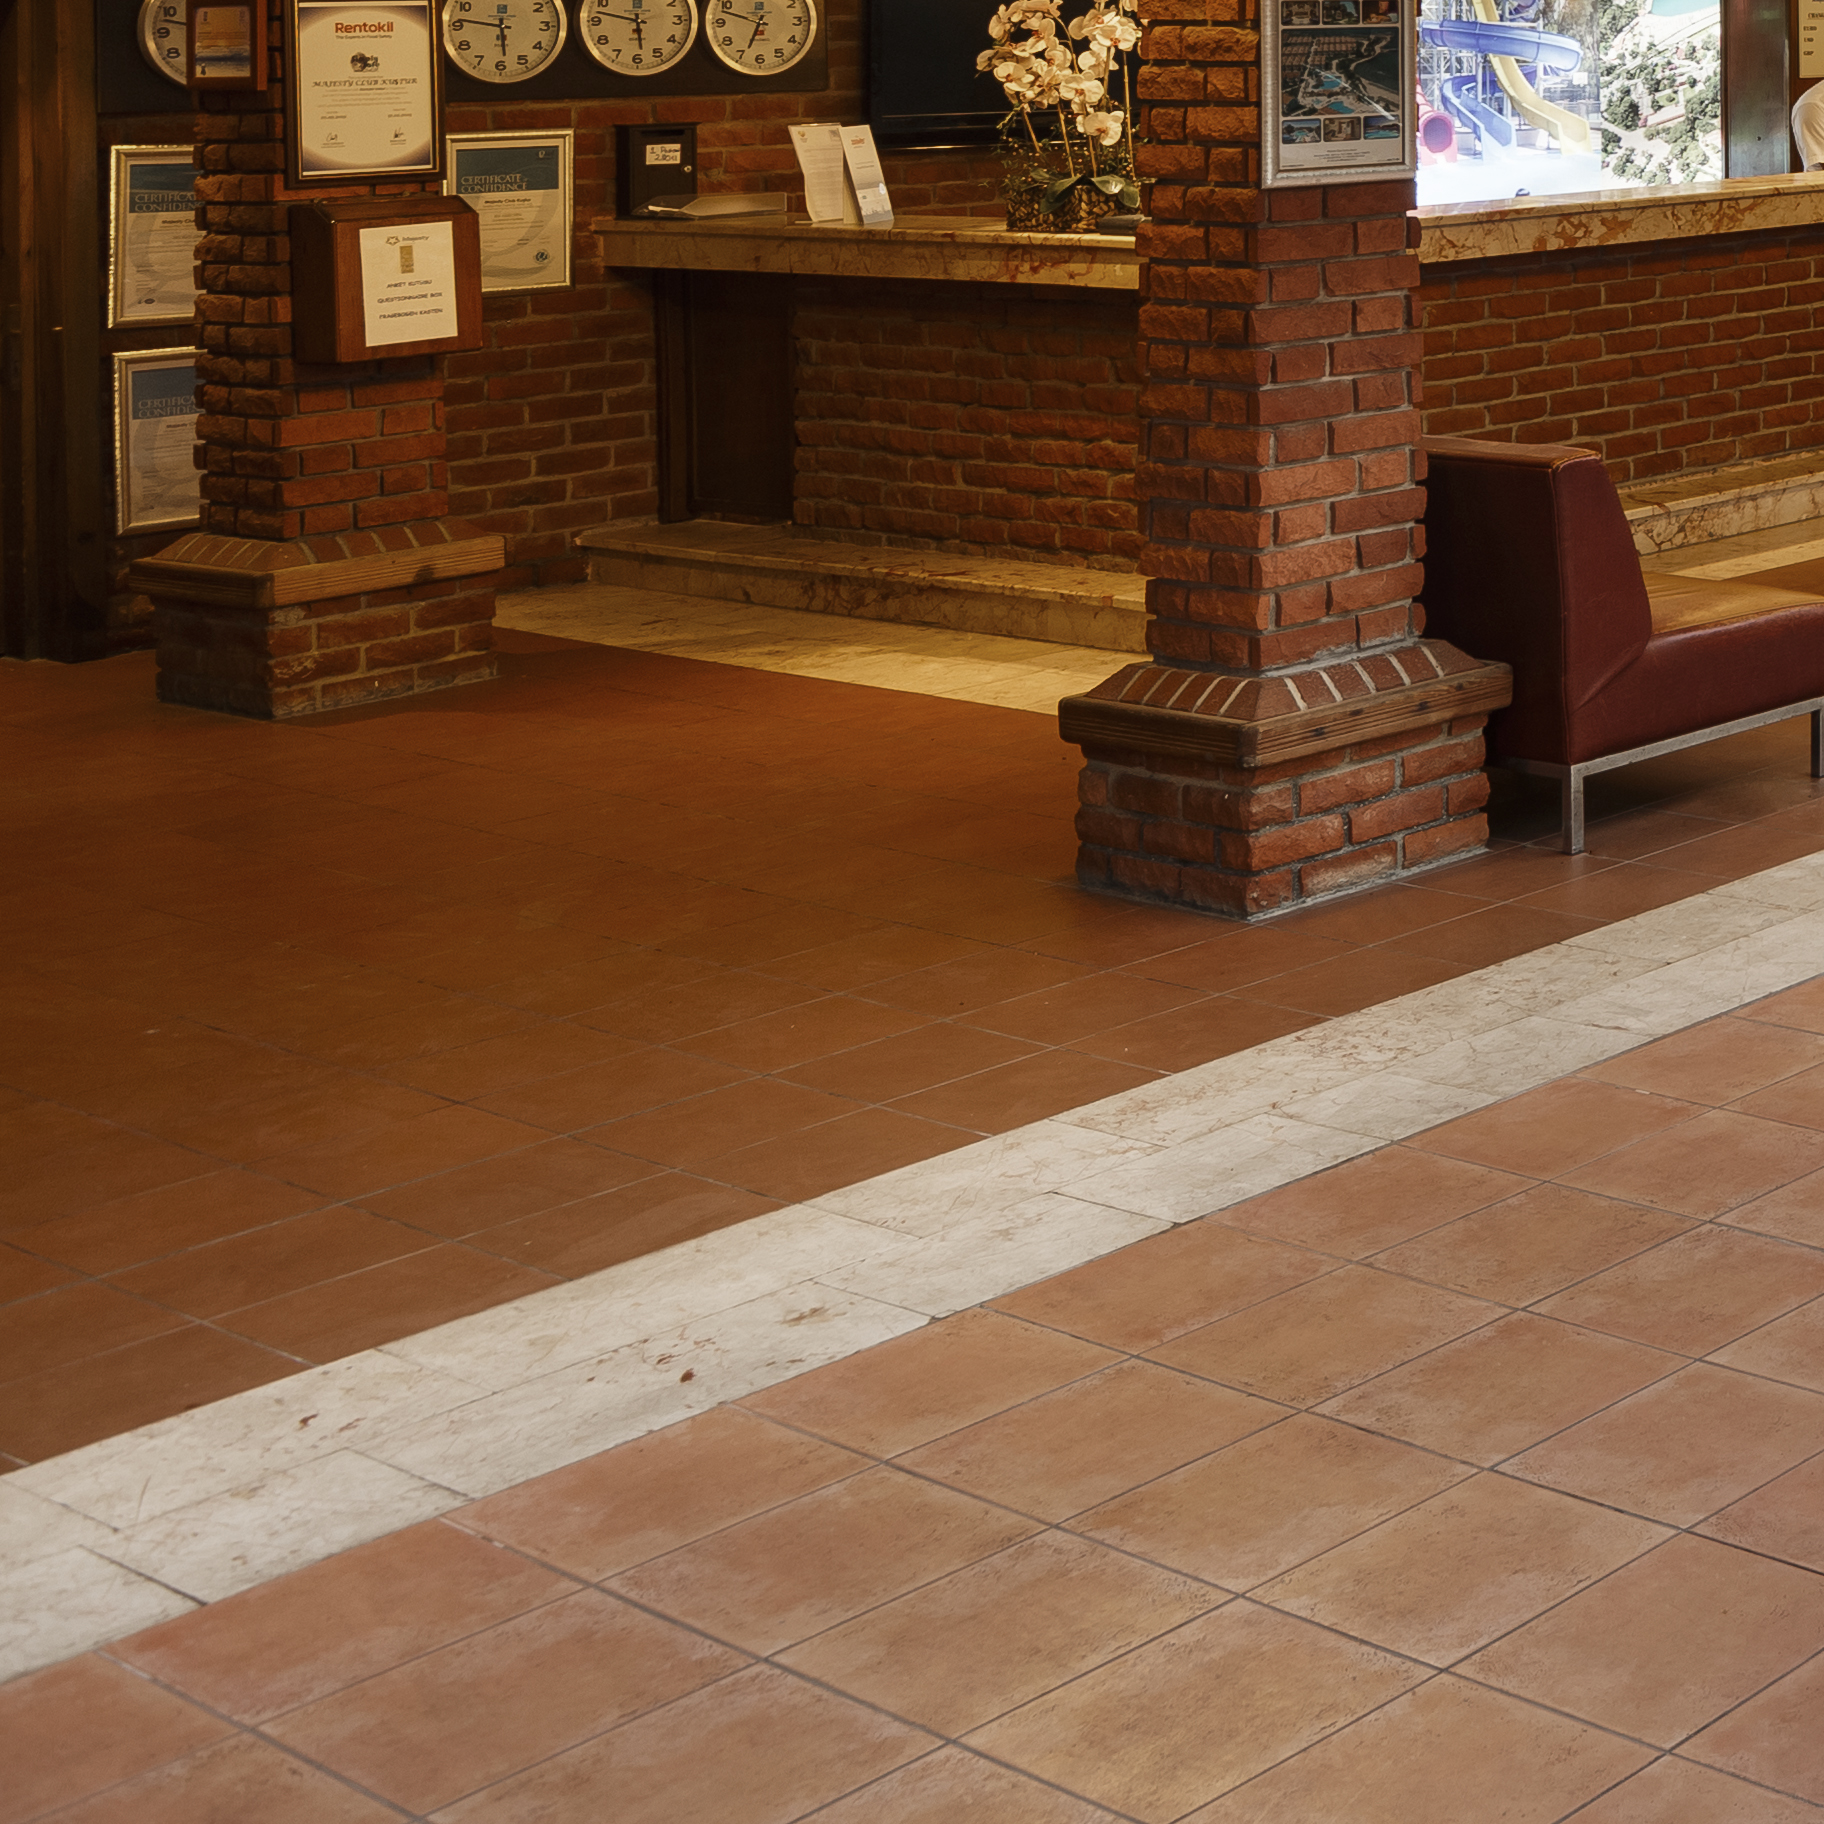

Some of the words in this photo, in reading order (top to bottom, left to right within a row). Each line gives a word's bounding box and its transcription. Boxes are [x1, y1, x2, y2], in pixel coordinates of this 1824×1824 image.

[459, 2, 472, 12] 10
[532, 2, 544, 13] 2
[721, 0, 732, 10] 10
[786, 0, 796, 9] 2
[163, 6, 177, 17] 10
[590, 16, 602, 26] 9
[672, 15, 683, 25] 3
[715, 18, 726, 28] 9
[792, 16, 802, 26] 3
[335, 22, 394, 34] Rentokil
[452, 21, 464, 31] 9
[539, 21, 551, 32] 3
[157, 27, 170, 39] 9
[597, 35, 609, 45] 8
[667, 34, 677, 44] 4
[722, 36, 733, 46] 8
[787, 34, 797, 44] 4
[458, 40, 471, 51] 8
[532, 40, 543, 51] 4
[166, 47, 181, 59] 8
[612, 49, 622, 59] 7
[652, 48, 663, 58] 5
[736, 50, 745, 59] 7
[774, 48, 784, 58] 5
[474, 55, 484, 66] 7
[516, 55, 528, 65] 5
[632, 54, 643, 64] 6
[754, 54, 765, 64] 6
[494, 60, 506, 71] 6
[461, 174, 521, 184] CERTIFICATE
[461, 182, 527, 193] CONFIDENCE
